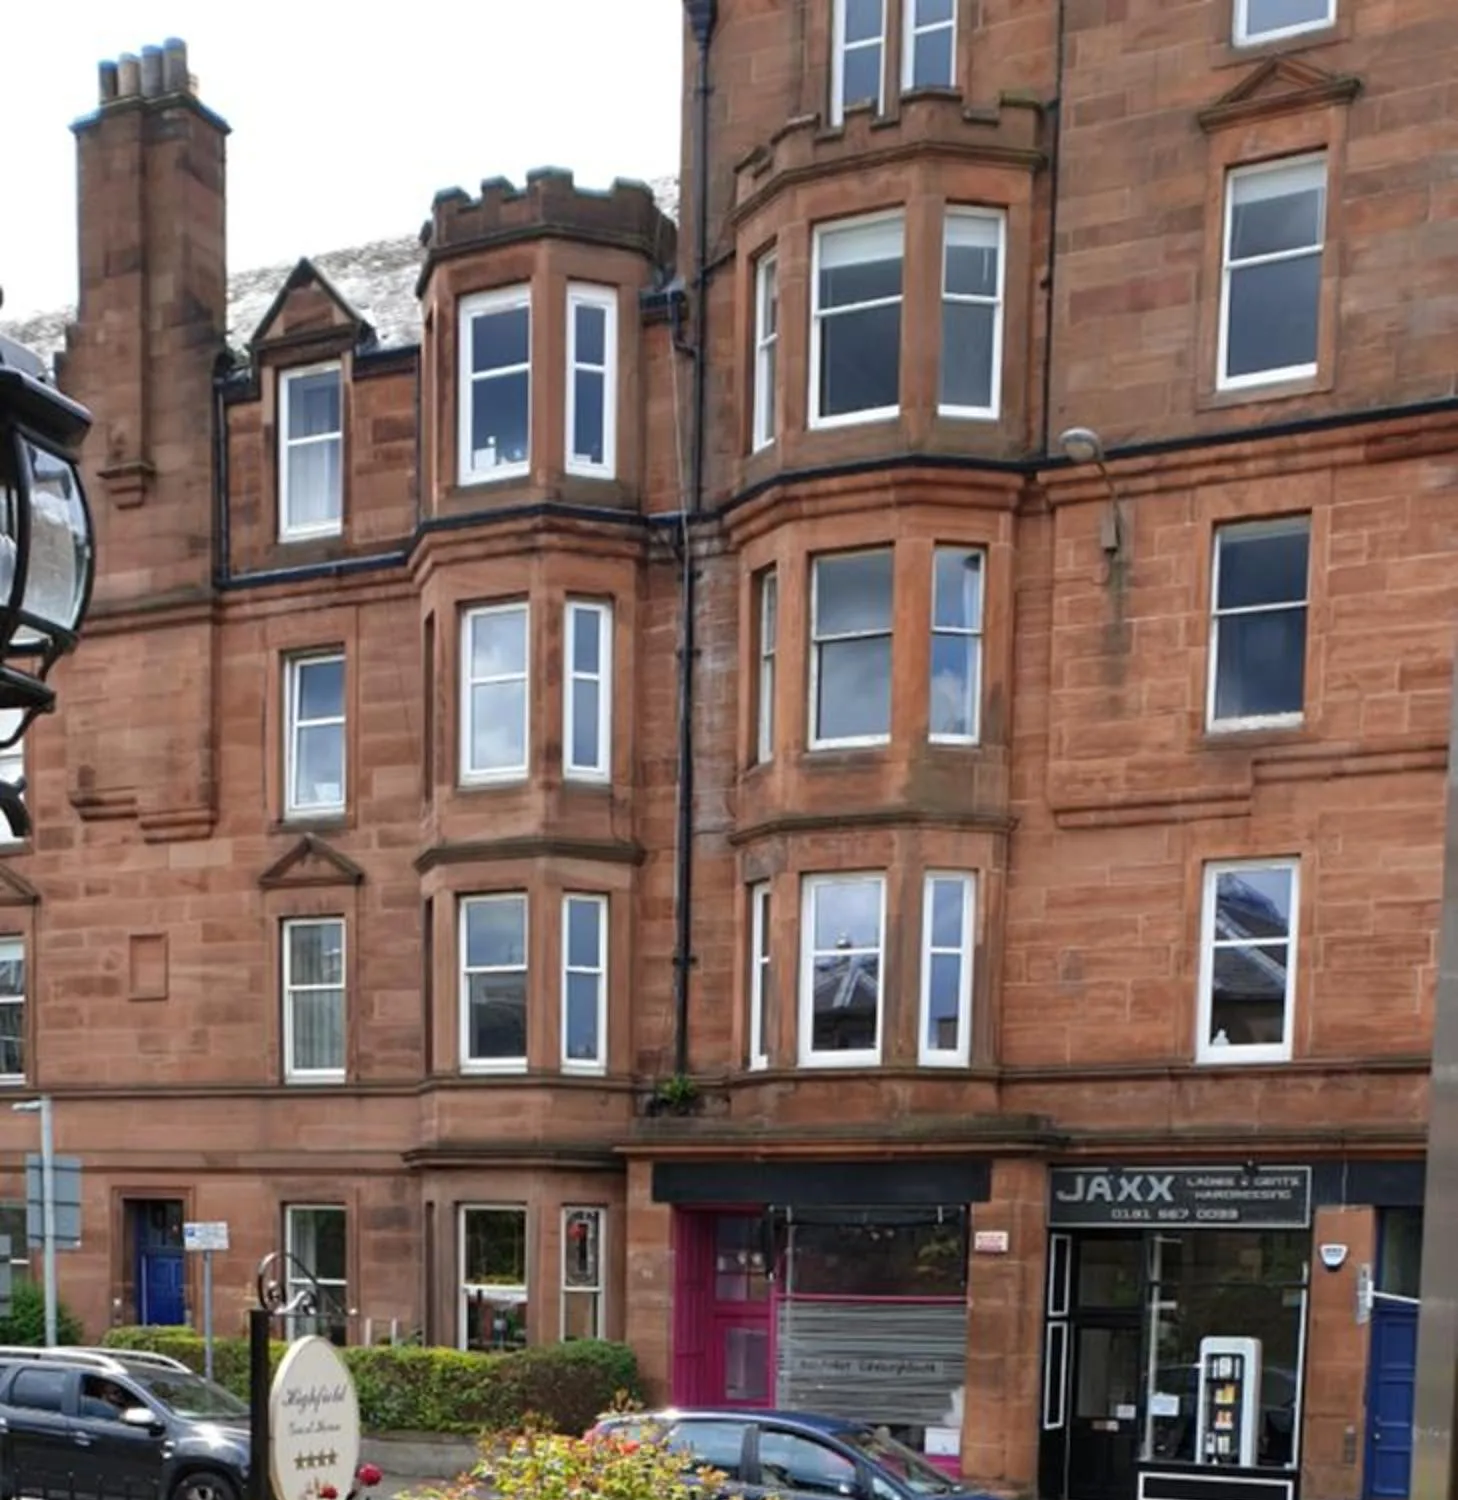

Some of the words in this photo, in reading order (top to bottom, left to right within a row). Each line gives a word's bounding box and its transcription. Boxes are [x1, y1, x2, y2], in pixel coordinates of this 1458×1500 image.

[1056, 1174, 1176, 1202] JAXX
[1186, 1177, 1236, 1188] LADIES
[1253, 1176, 1299, 1187] GENTS
[1194, 1188, 1292, 1200] HAIRDRESSING
[281, 1384, 347, 1416] Highfield
